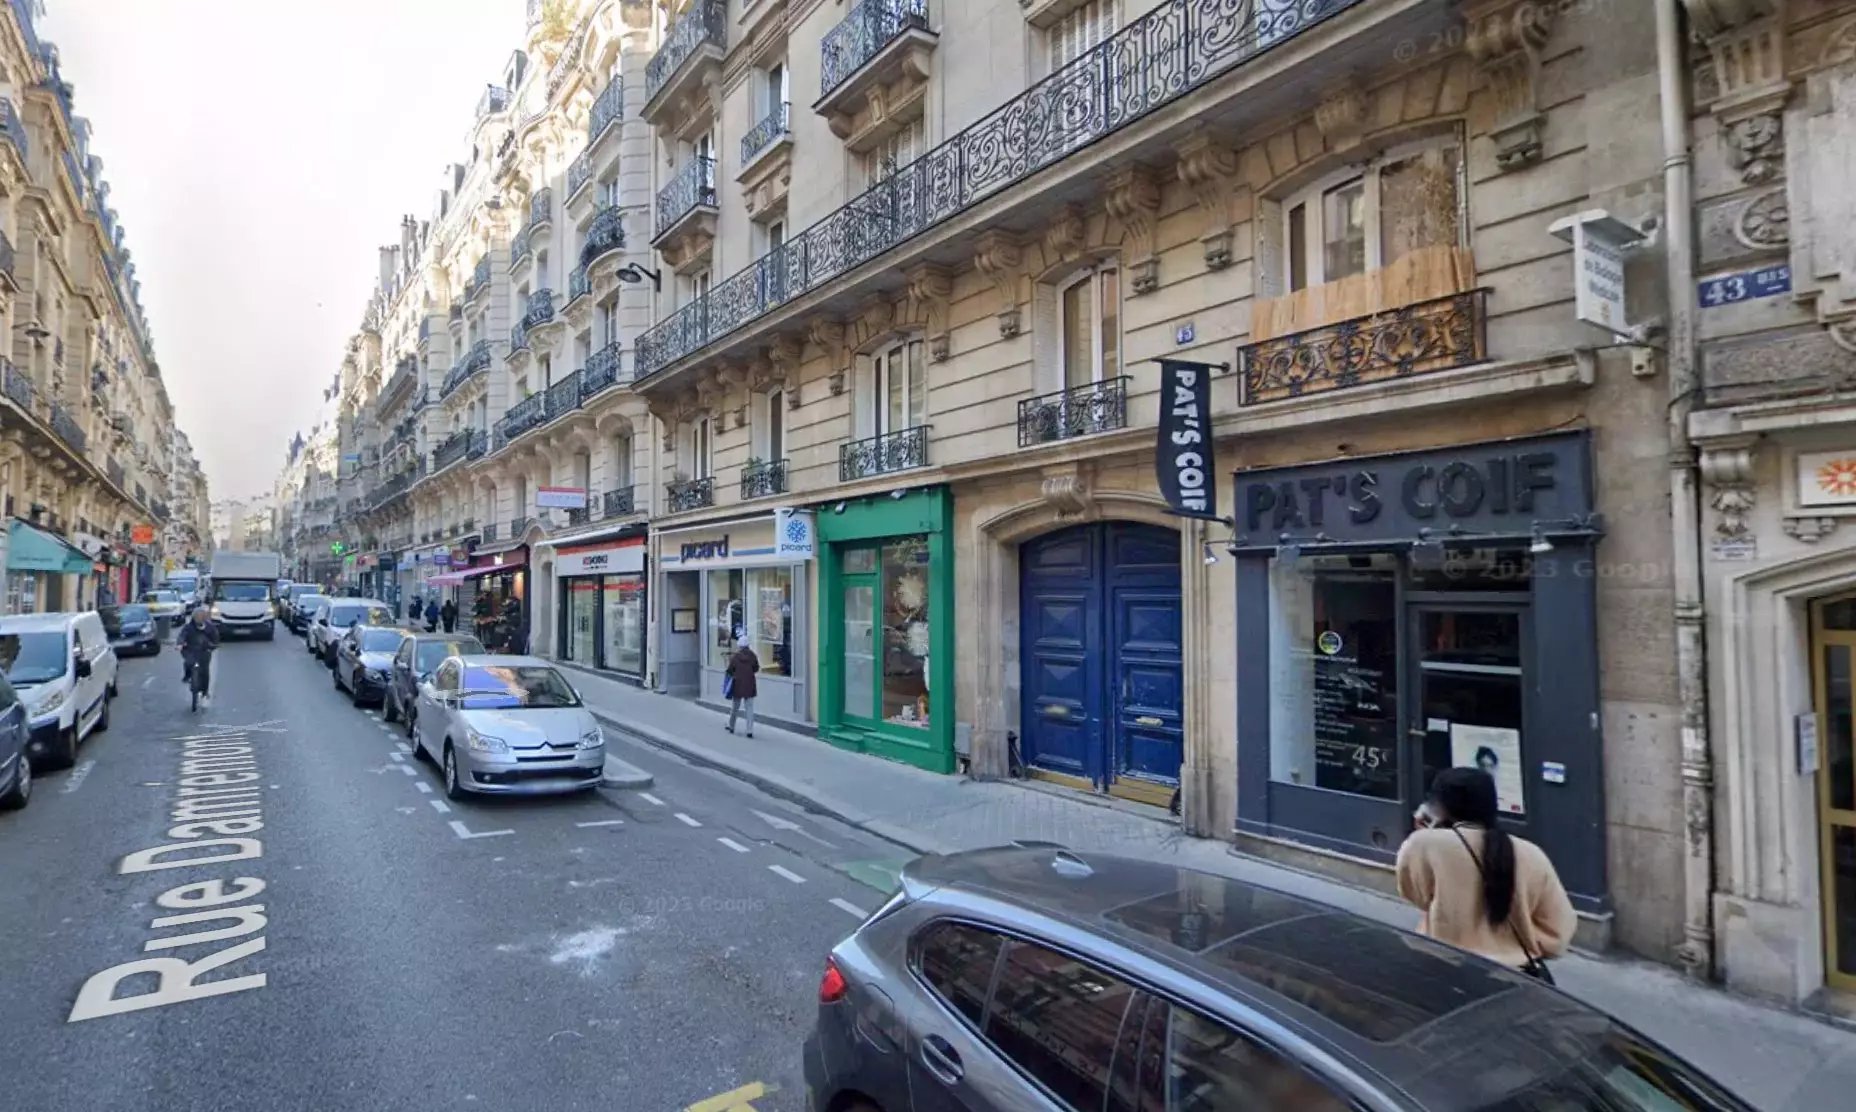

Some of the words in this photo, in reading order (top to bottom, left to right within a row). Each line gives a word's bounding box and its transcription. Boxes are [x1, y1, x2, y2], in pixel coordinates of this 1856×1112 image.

[1705, 277, 1748, 304] 43
[1171, 370, 1201, 445] PAT'S
[1175, 452, 1207, 512] COIF
[1246, 469, 1383, 531] PAT'S
[1402, 452, 1558, 520] COIF
[681, 534, 729, 563] picard
[781, 543, 812, 552] picard
